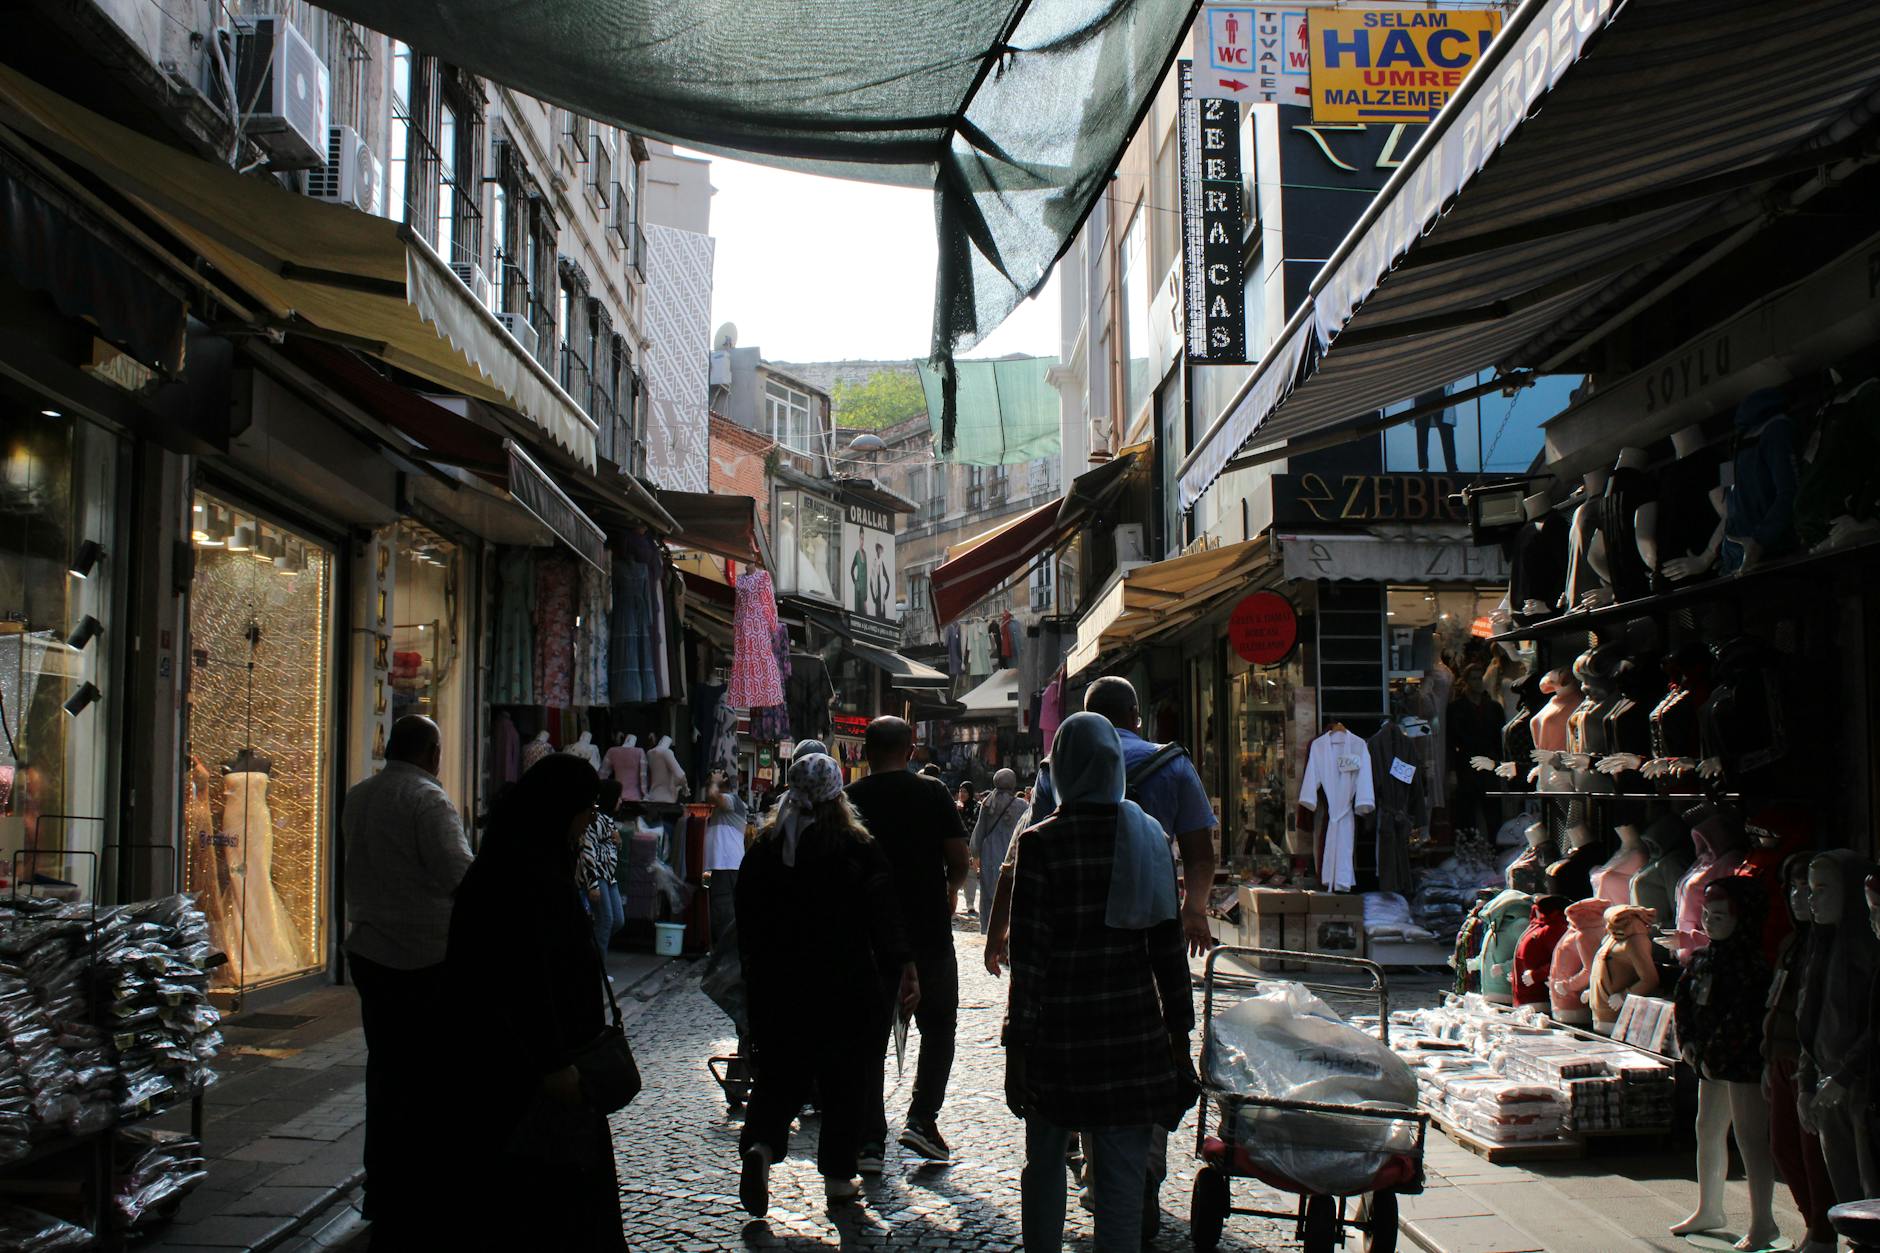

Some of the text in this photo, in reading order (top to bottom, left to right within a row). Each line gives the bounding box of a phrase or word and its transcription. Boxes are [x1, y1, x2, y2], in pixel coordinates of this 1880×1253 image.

[1363, 13, 1448, 28] SELAM
[1217, 47, 1247, 64] WC
[1259, 12, 1277, 101] TUVALET
[1289, 52, 1309, 68] W
[1363, 70, 1462, 87] UMRE
[1461, 0, 1612, 177] PERDE
[1325, 89, 1450, 107] MALZEME
[1205, 98, 1228, 245] ZEBRA
[1645, 334, 1731, 412] SOYLU
[1339, 473, 1464, 520] ZEBR
[850, 505, 888, 530] ORALLAR
